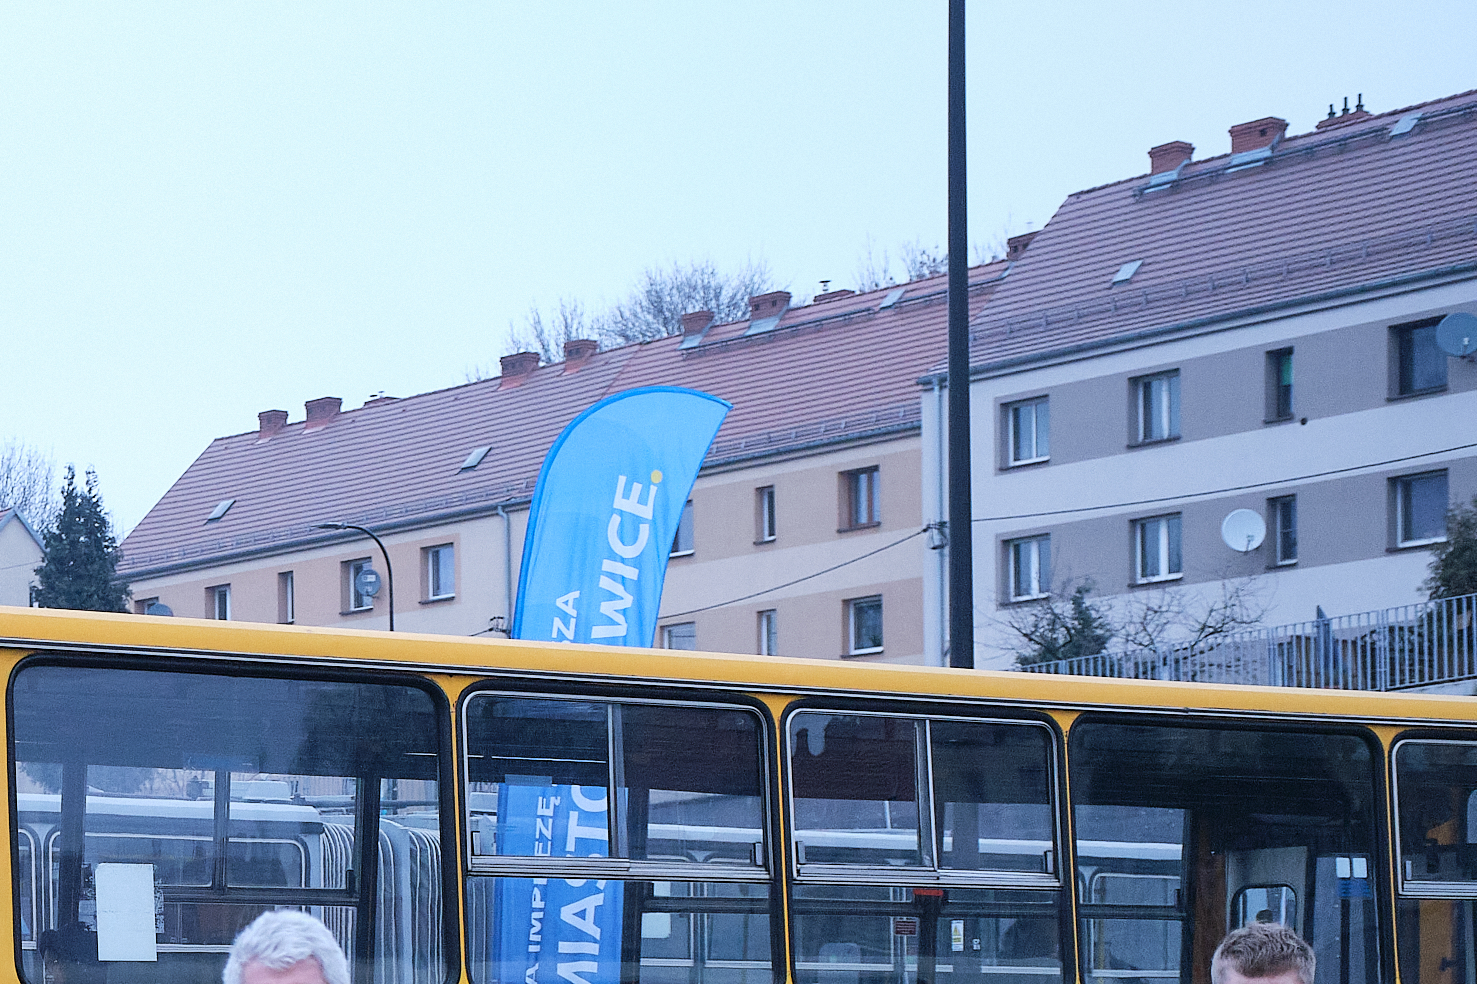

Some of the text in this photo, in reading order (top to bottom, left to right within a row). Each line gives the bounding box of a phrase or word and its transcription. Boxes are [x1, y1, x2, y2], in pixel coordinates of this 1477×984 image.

[590, 470, 662, 644] WICE.
[528, 796, 561, 953] IMPEZĘ
[551, 590, 580, 643] ZA
